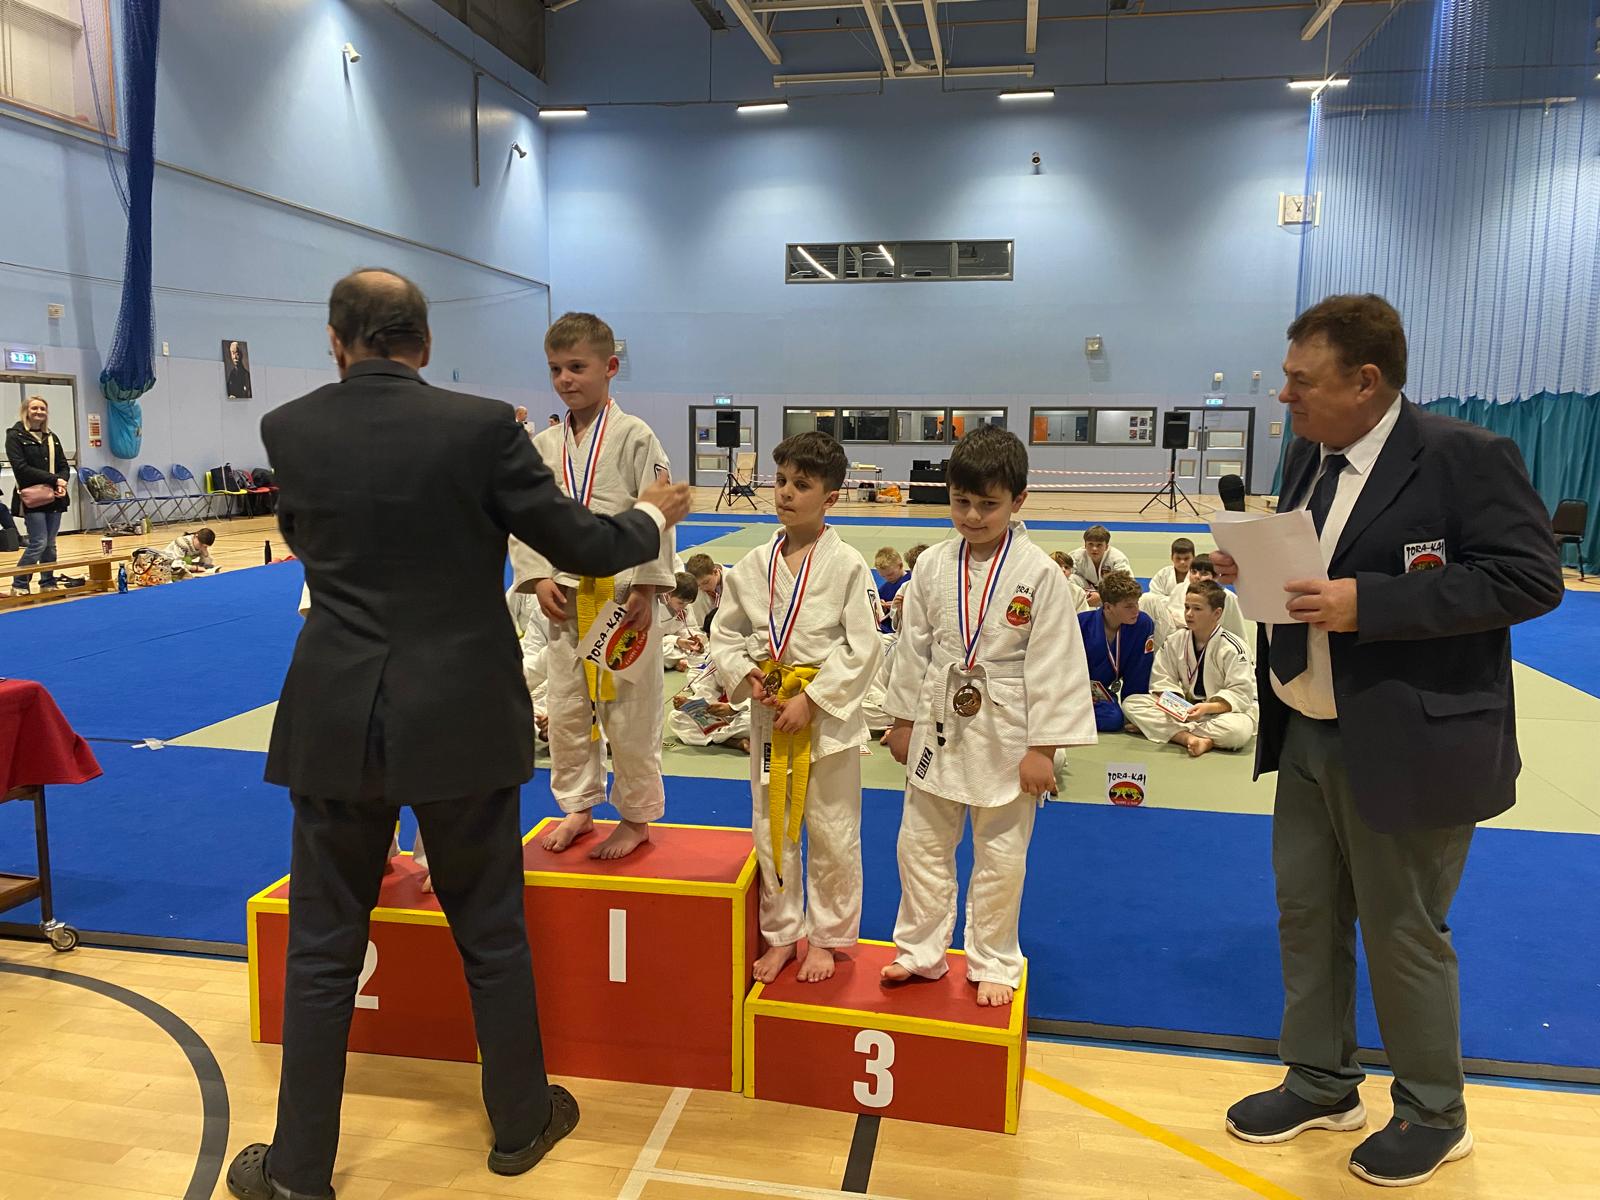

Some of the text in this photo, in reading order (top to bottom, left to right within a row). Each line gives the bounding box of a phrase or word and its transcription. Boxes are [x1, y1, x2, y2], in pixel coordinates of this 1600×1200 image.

[1406, 541, 1444, 560] TORA-KAI
[586, 606, 628, 664] TORA-KAI
[916, 747, 932, 778] BLITZ
[1108, 772, 1146, 786] TORA-KAI
[853, 1029, 895, 1108] 3
